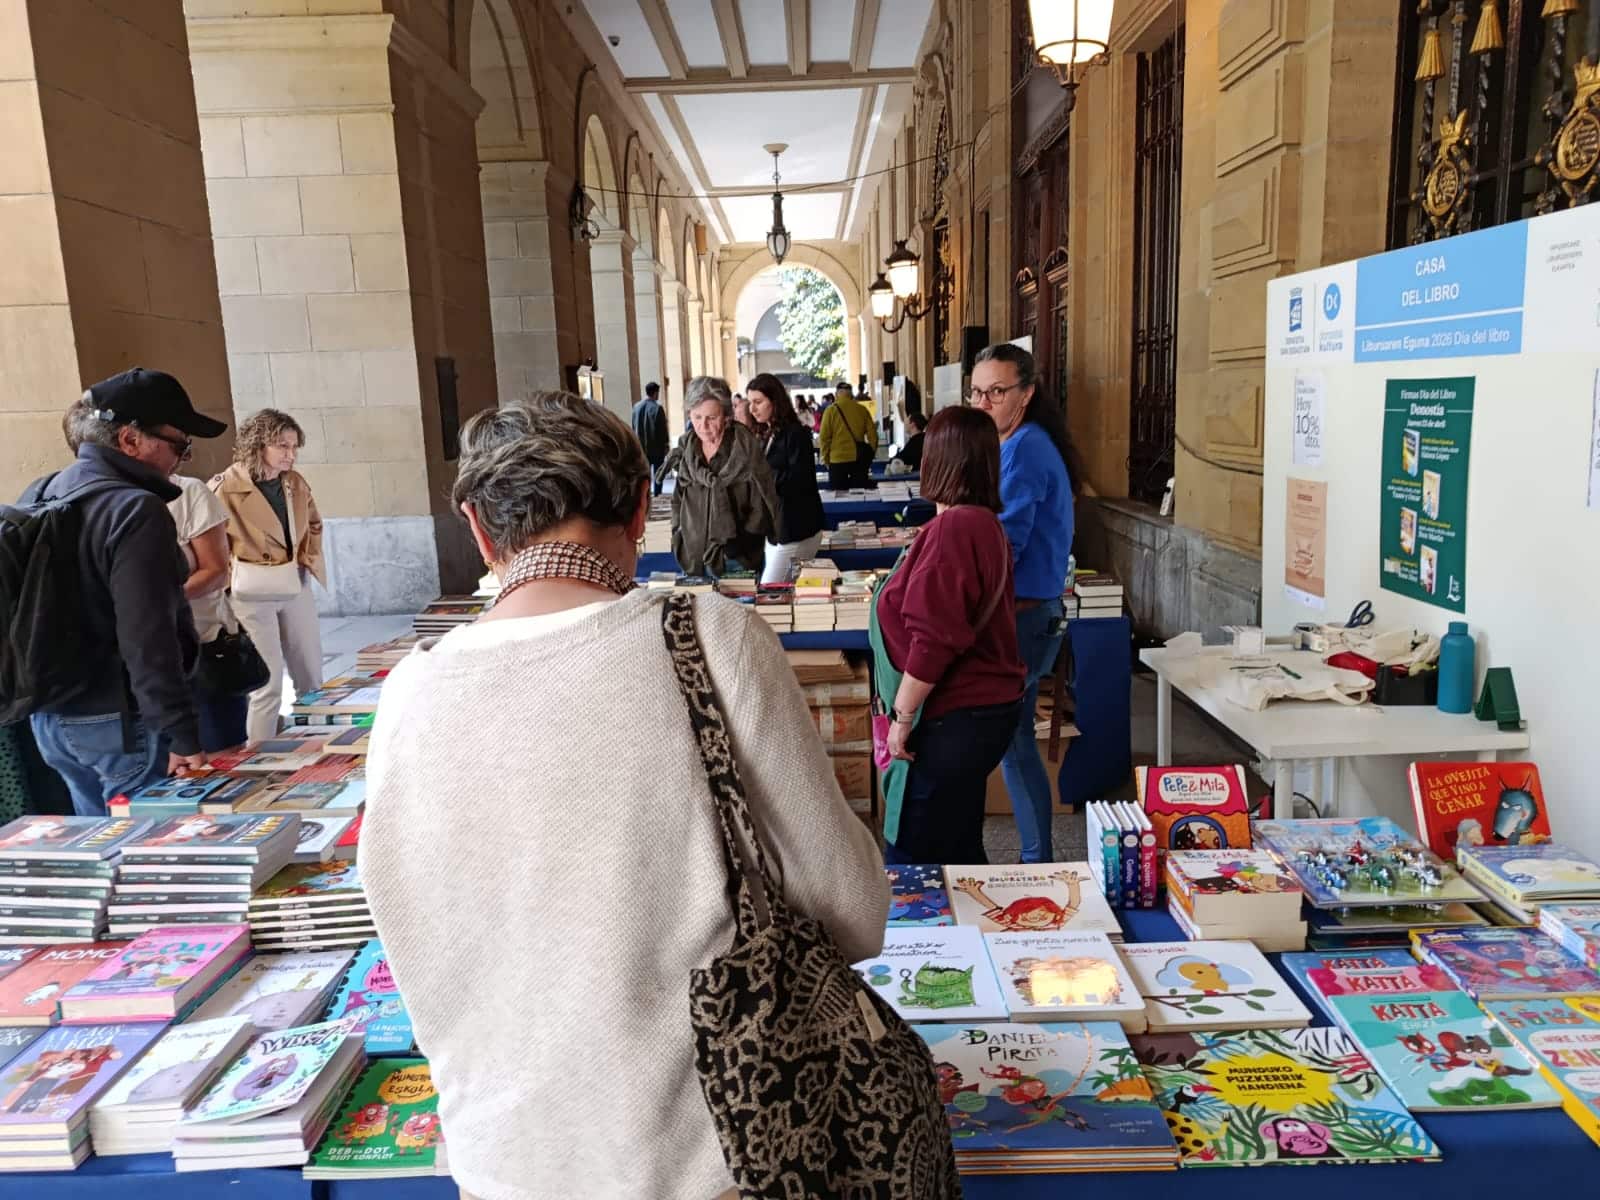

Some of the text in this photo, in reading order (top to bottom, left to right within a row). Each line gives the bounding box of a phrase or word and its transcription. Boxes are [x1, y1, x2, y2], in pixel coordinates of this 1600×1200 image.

[1415, 255, 1446, 276] CASA
[1401, 283, 1460, 307] DEL LIBRO
[1403, 336, 1429, 351] Eguna
[1471, 329, 1487, 343] del
[1488, 327, 1510, 342] libro
[1296, 414, 1320, 435] 10%
[1200, 778, 1226, 791] Mila
[1428, 766, 1491, 788] LA OVEJITA
[1429, 781, 1486, 800] QUE VINO A
[1436, 793, 1485, 815] CENAR
[40, 948, 121, 960] MOMO
[1321, 957, 1388, 969] KATTA
[1346, 975, 1418, 993] KATTA
[1370, 1001, 1448, 1022] KATTA
[988, 1046, 1057, 1062] PIRATA
[1226, 1074, 1306, 1083] PUZKERRIK
[1228, 1066, 1293, 1074] MUNDUKO
[388, 1085, 434, 1094] ESKOLA
[1236, 1083, 1306, 1091] HANDIENA
[328, 1147, 352, 1155] DEB
[364, 1146, 390, 1154] DOT
